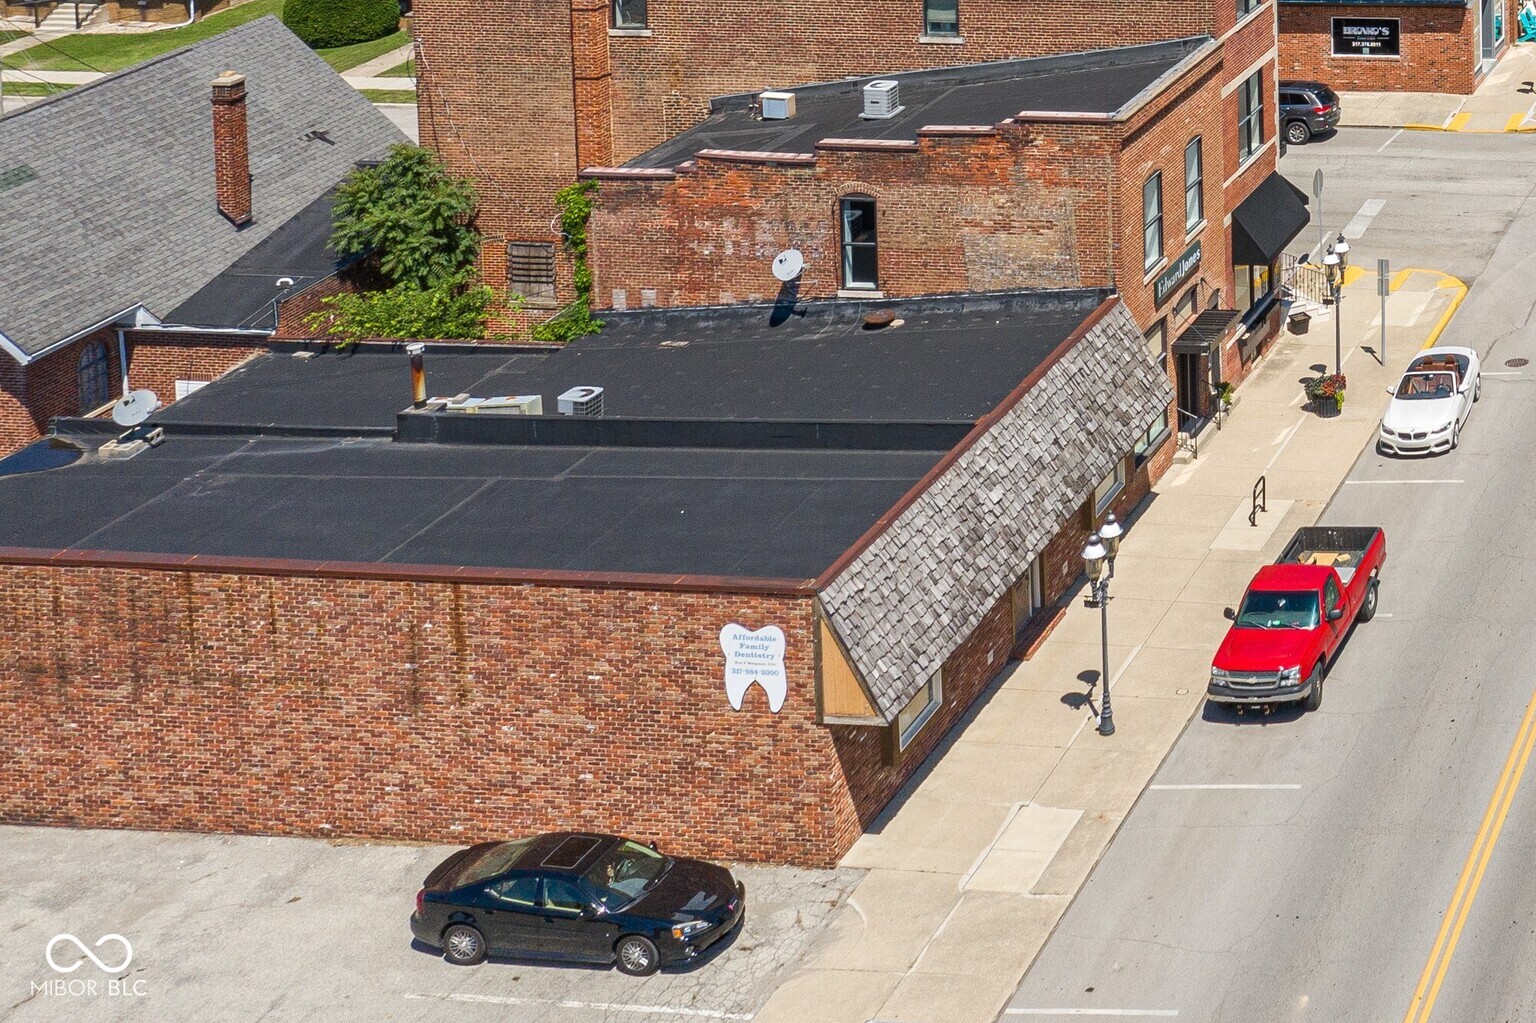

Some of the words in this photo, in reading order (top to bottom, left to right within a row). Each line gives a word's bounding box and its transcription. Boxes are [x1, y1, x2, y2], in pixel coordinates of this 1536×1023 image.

[1158, 263, 1182, 298] Edward
[1181, 248, 1201, 277] Jones
[732, 634, 777, 642] Affordable
[739, 643, 770, 651] Family
[734, 651, 775, 660] Dentistry
